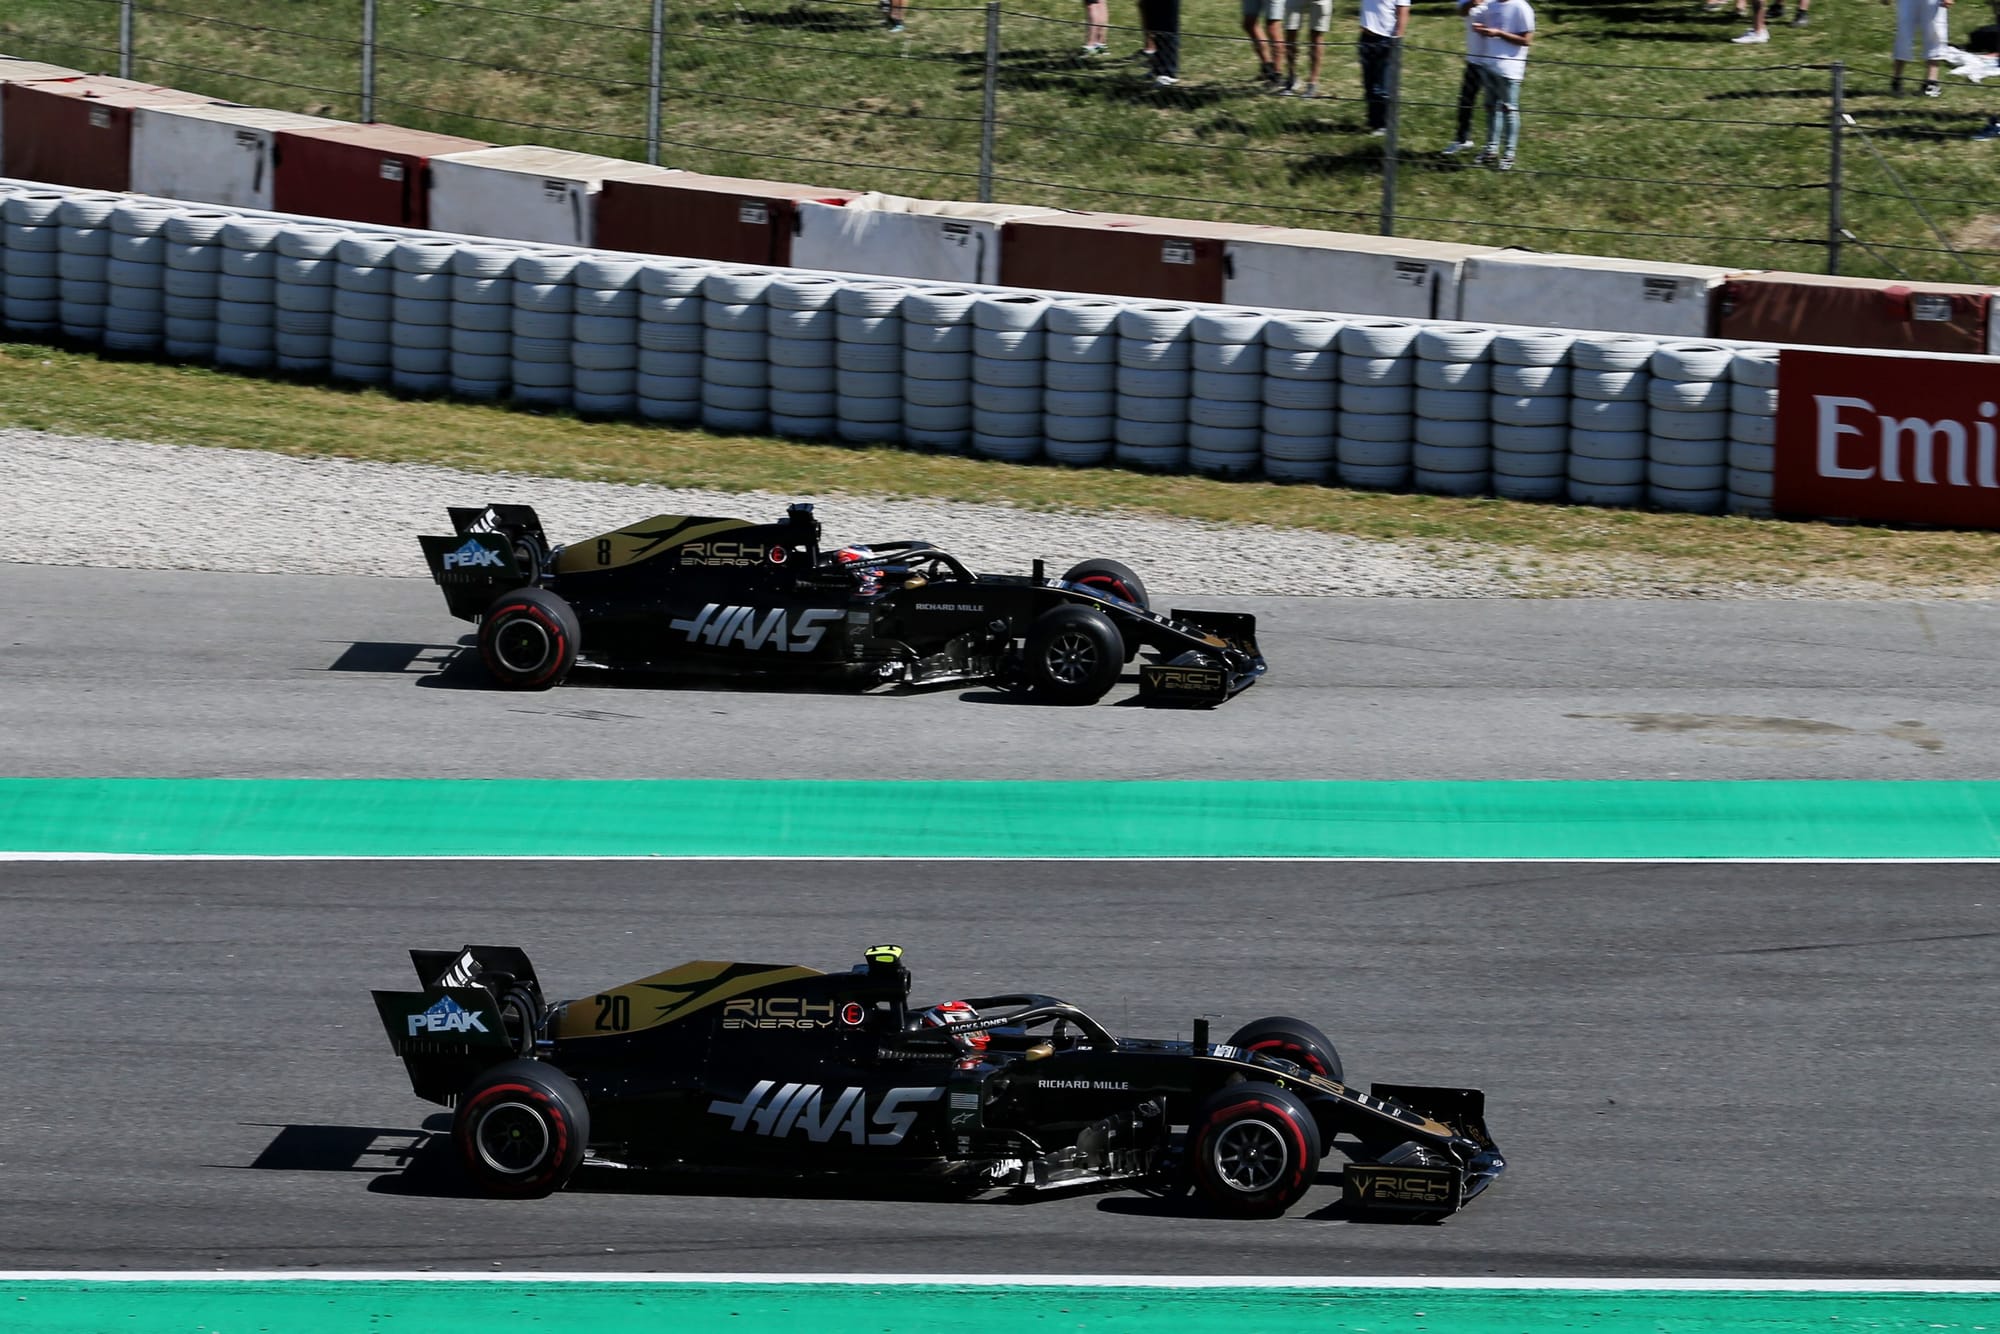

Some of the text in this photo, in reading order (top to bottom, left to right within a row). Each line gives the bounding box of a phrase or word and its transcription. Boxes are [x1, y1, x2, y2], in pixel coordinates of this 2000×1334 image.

[1812, 394, 2000, 488] Emi
[597, 539, 611, 565] 8
[681, 542, 764, 557] RICH
[443, 550, 505, 570] PEAK
[680, 557, 763, 566] ENERGY
[915, 603, 984, 612] RICHARD MILLE
[669, 603, 847, 652] HAAS
[1165, 672, 1221, 685] RICH
[595, 994, 630, 1031] 20
[723, 998, 834, 1017] RICH
[408, 1011, 489, 1036] PEAK
[722, 1018, 833, 1029] ENERGY
[1038, 1080, 1129, 1090] RICHARD MILLE
[707, 1079, 947, 1145] HAAS
[1374, 1176, 1450, 1193] RICH
[1374, 1190, 1449, 1201] ENERGY
